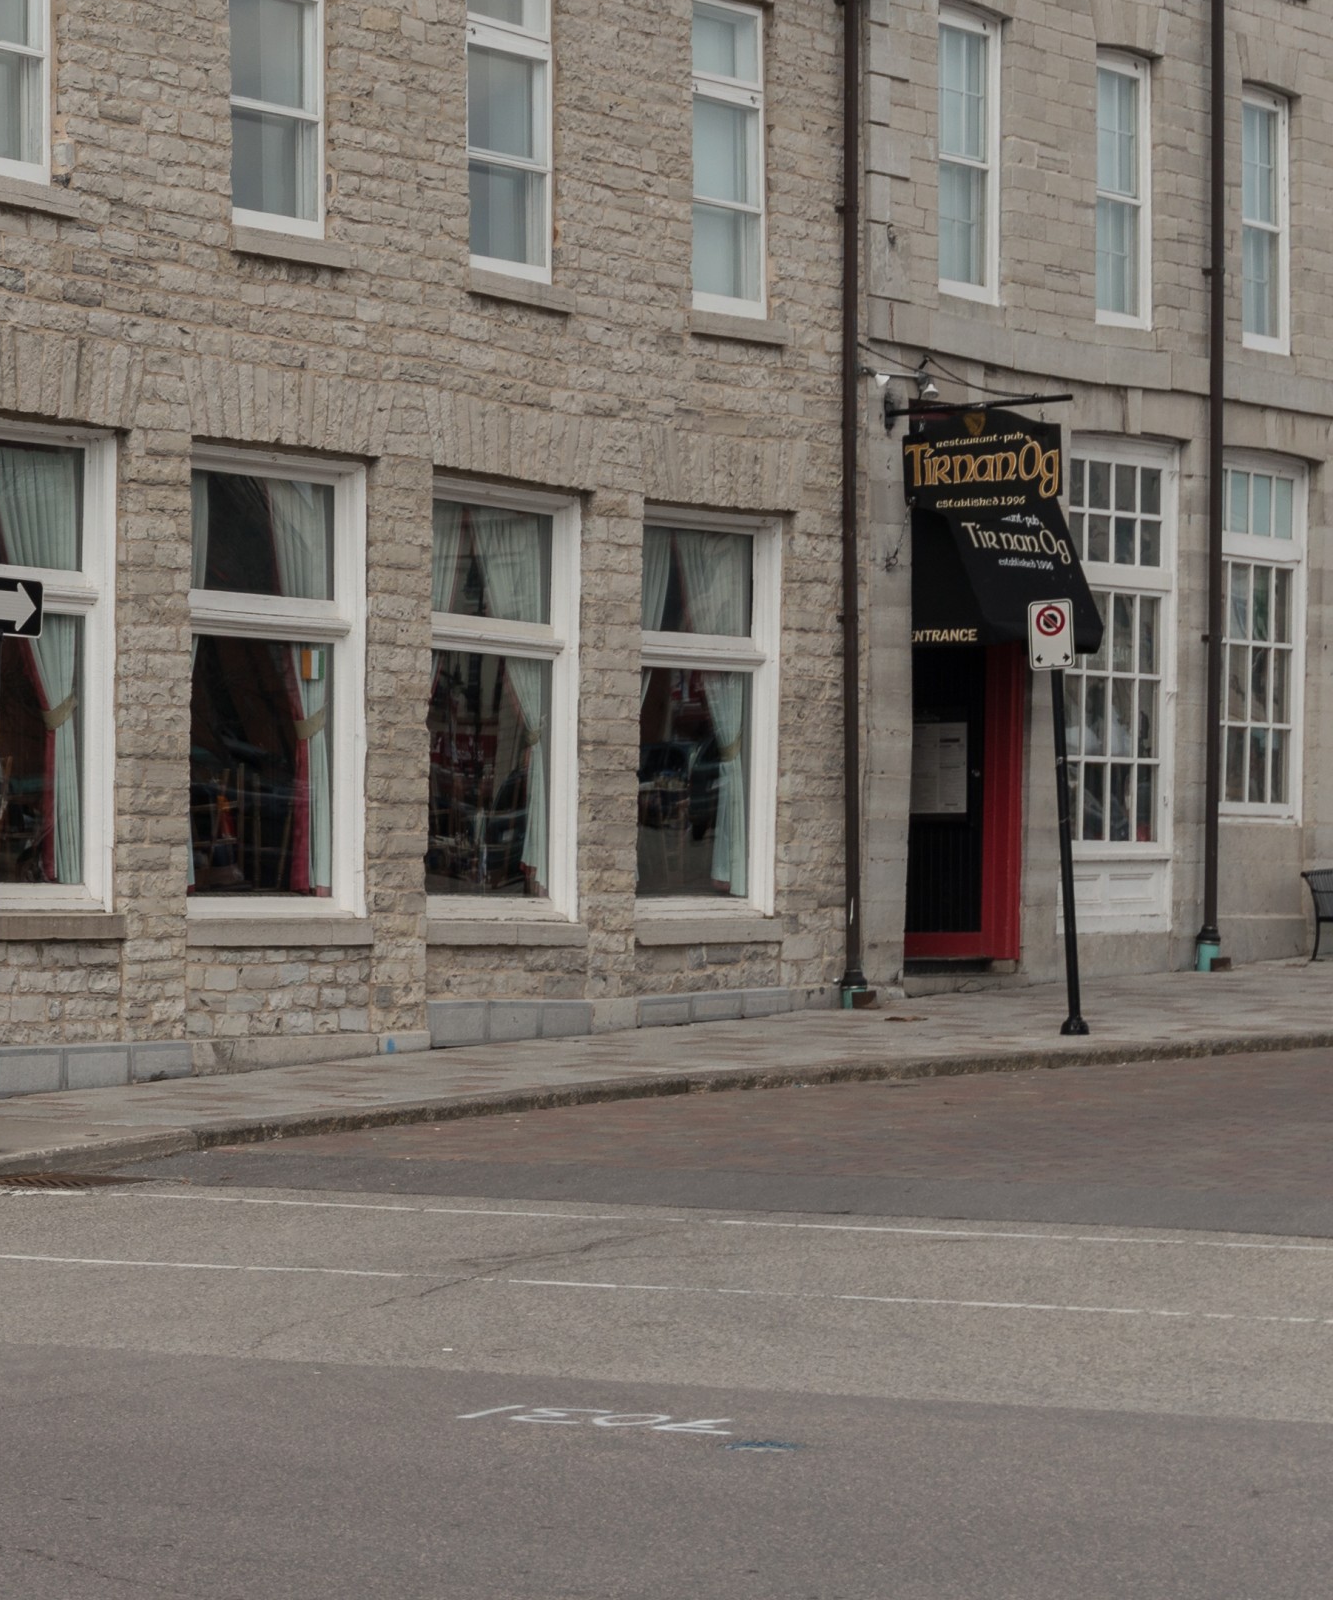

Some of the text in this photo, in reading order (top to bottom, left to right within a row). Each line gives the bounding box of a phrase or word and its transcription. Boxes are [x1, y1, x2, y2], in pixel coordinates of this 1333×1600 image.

[936, 432, 1024, 448] restaurant pub
[936, 495, 1026, 509] established 1996
